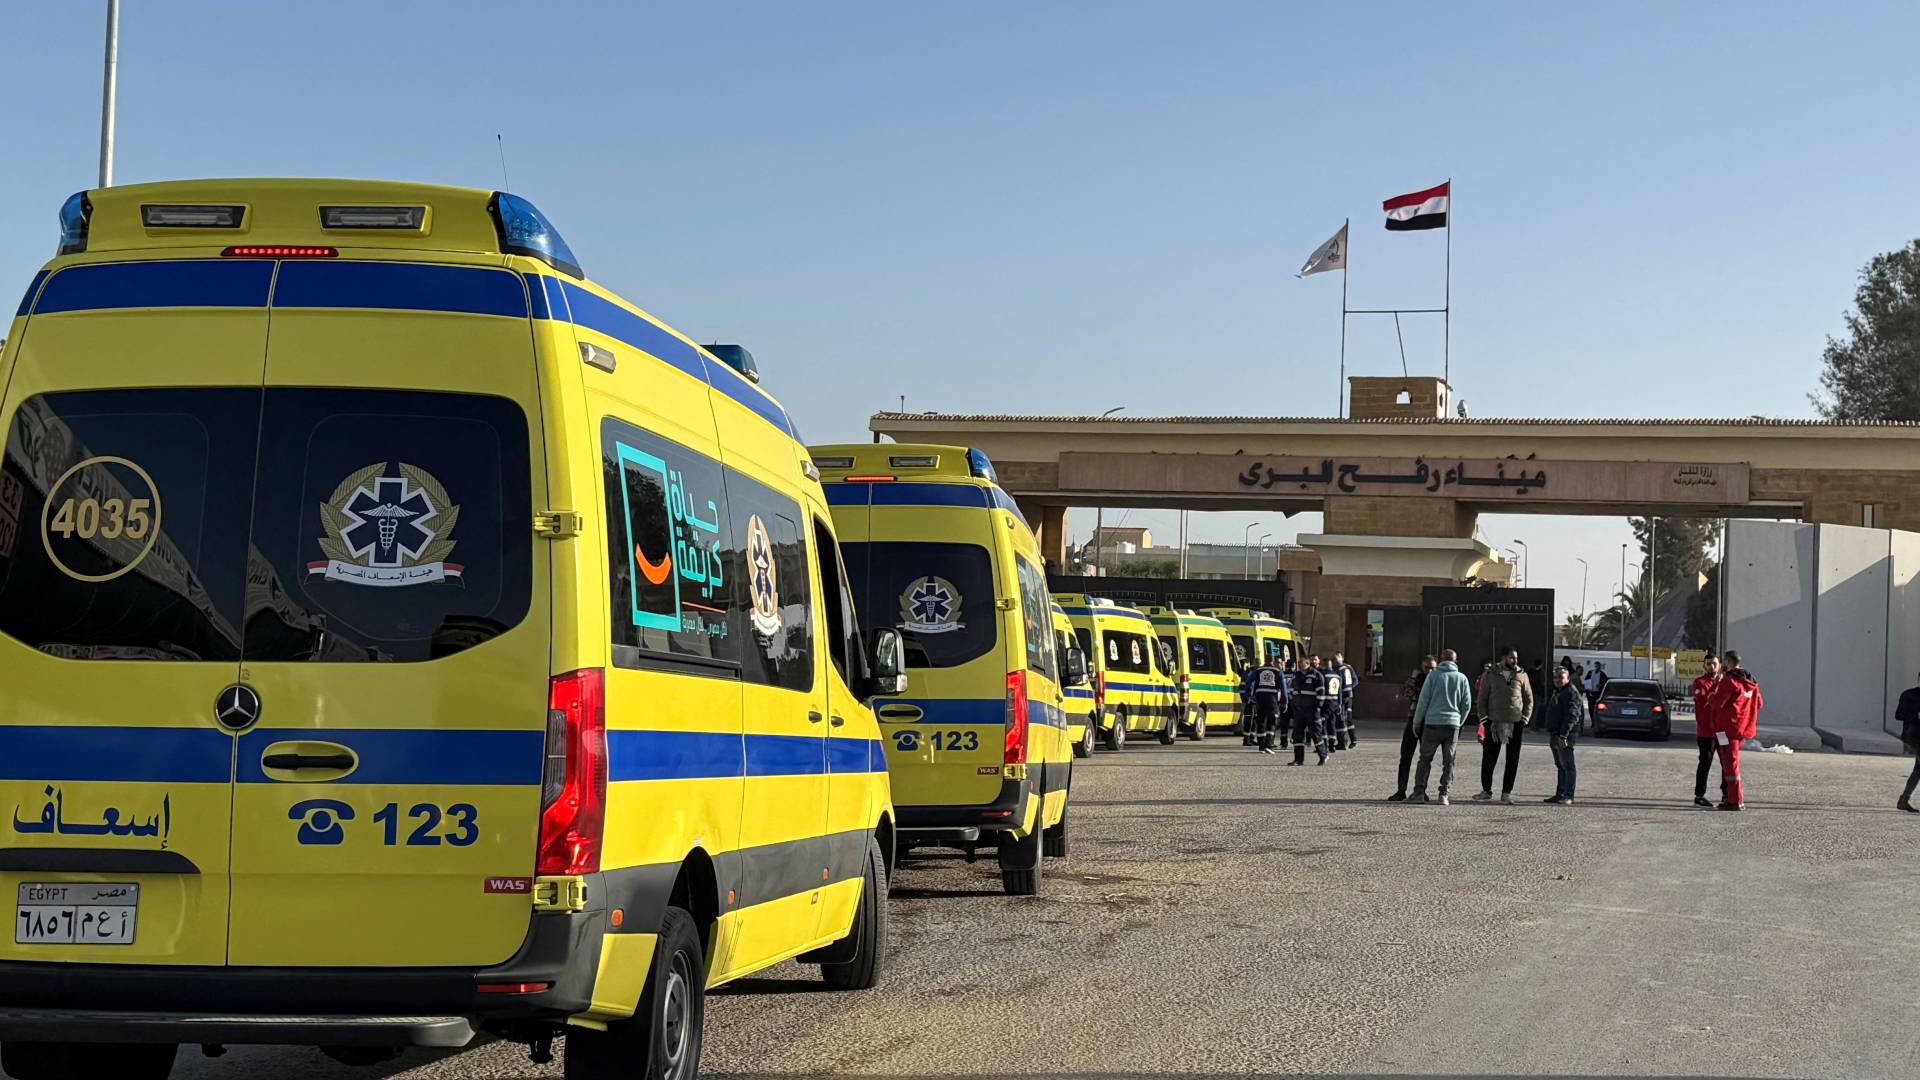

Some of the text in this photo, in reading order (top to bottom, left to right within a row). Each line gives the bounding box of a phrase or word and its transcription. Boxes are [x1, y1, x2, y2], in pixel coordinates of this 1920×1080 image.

[1337, 455, 1441, 493] رفح
[1443, 461, 1546, 495] ميناء
[51, 498, 150, 540] 4035
[670, 469, 719, 540] حياة
[335, 562, 433, 583] هيئة الإسعاف المصرية
[676, 526, 723, 600] كريمة
[931, 731, 979, 752] 123
[13, 784, 170, 850] إسعاف
[373, 802, 480, 846] 123
[29, 888, 68, 901] EGYPT
[92, 889, 127, 900] مصر
[490, 879, 525, 890] WAS
[20, 910, 74, 938] ٦٨٥٦
